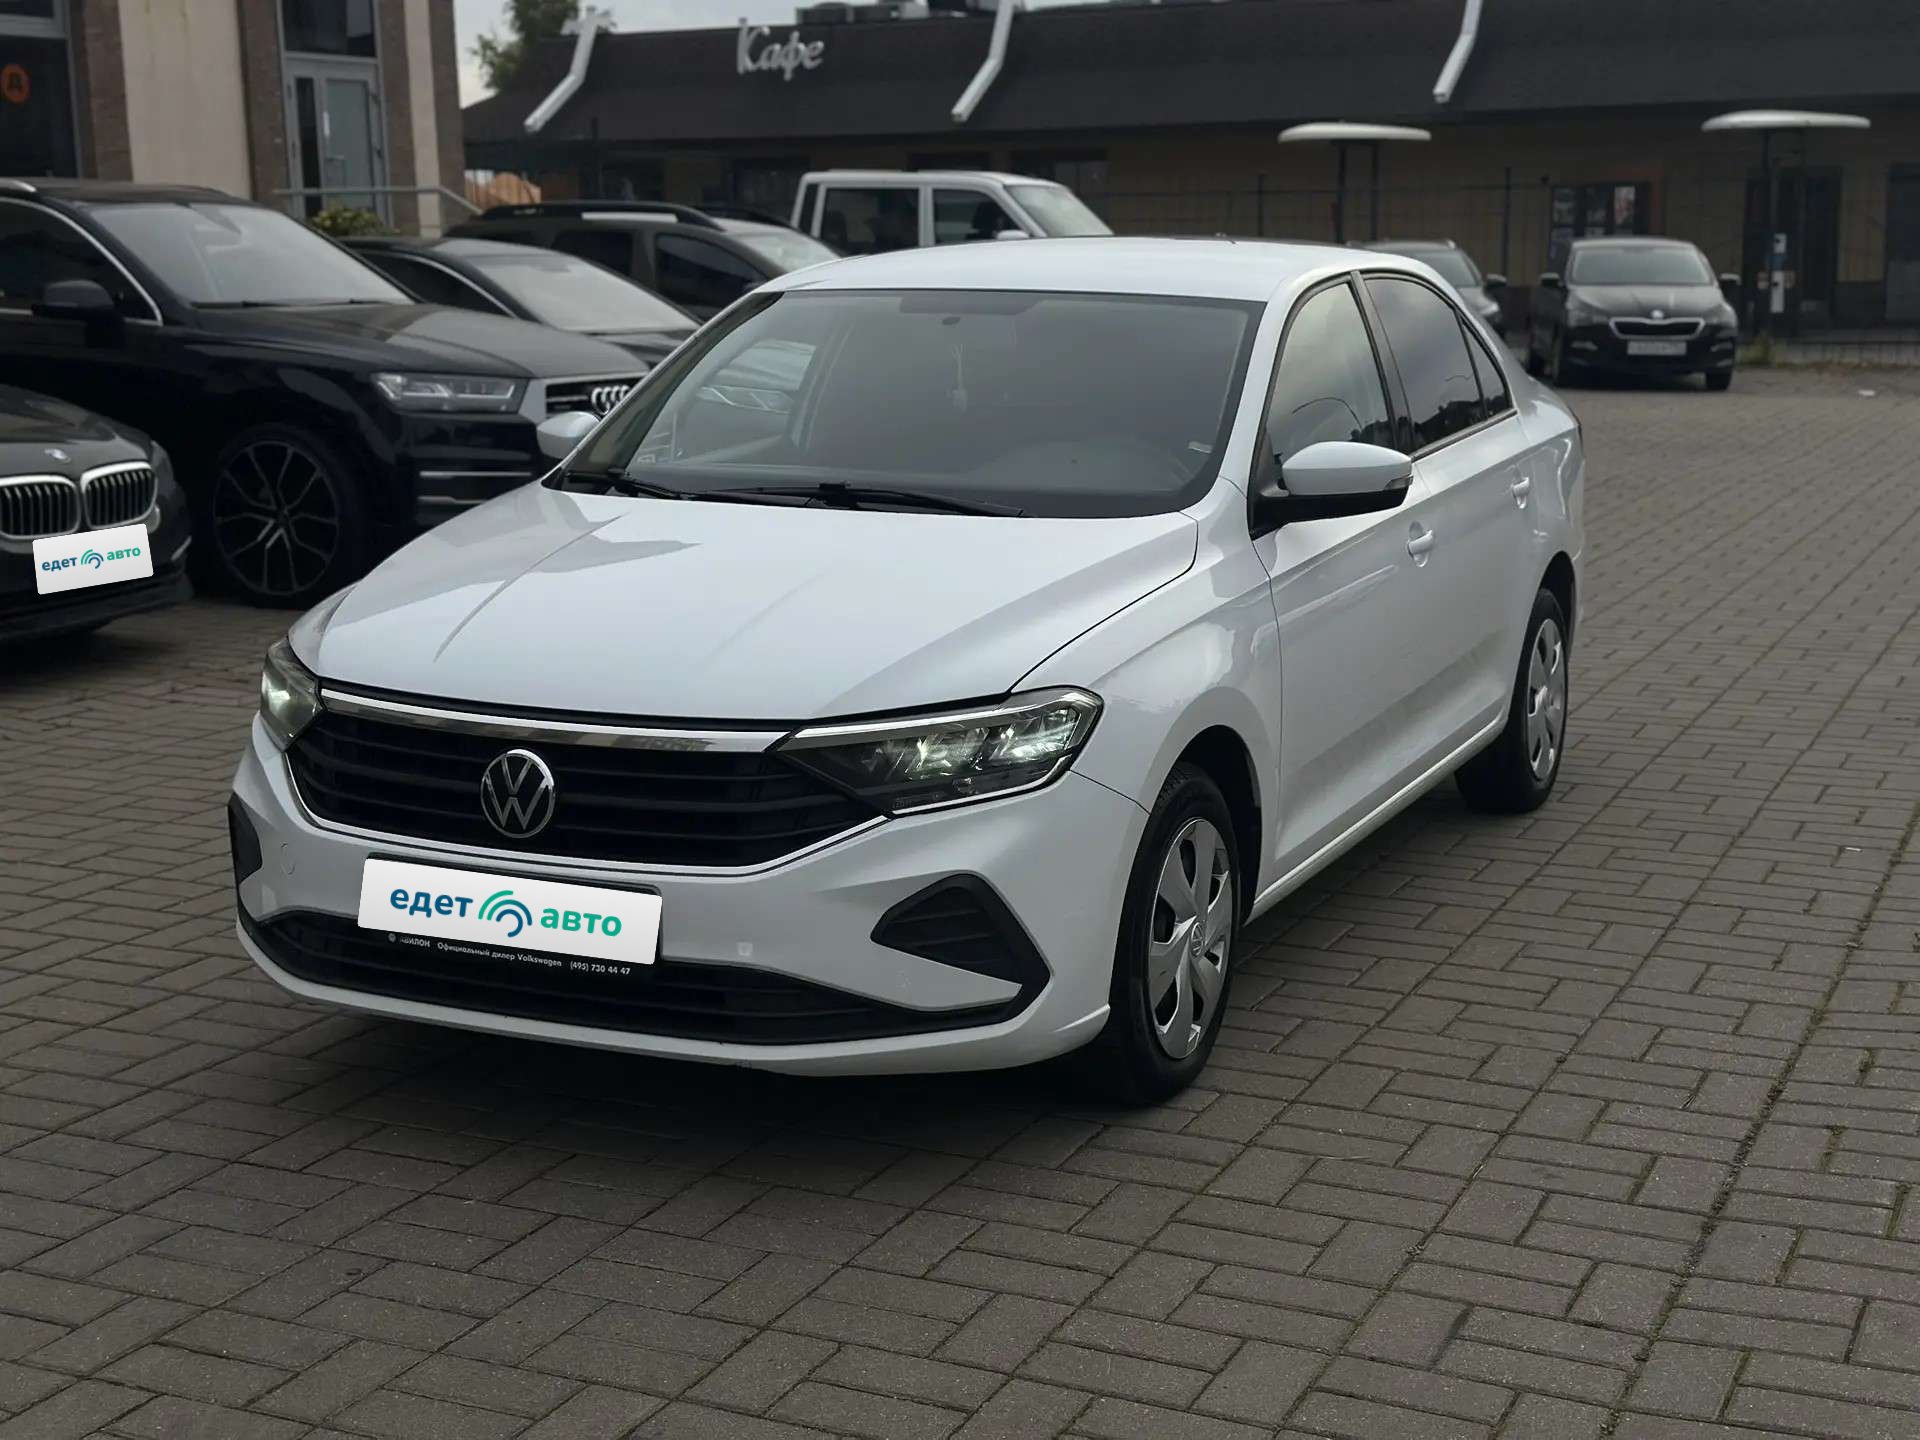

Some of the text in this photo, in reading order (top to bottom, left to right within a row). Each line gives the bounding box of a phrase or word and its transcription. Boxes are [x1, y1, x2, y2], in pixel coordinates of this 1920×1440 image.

[738, 18, 824, 81] Кафе
[491, 951, 516, 961] дилер
[517, 954, 562, 967] Volkswagen
[570, 961, 589, 972] (495)
[591, 964, 606, 973] 730
[607, 966, 618, 974] 44
[620, 967, 631, 975] 47
